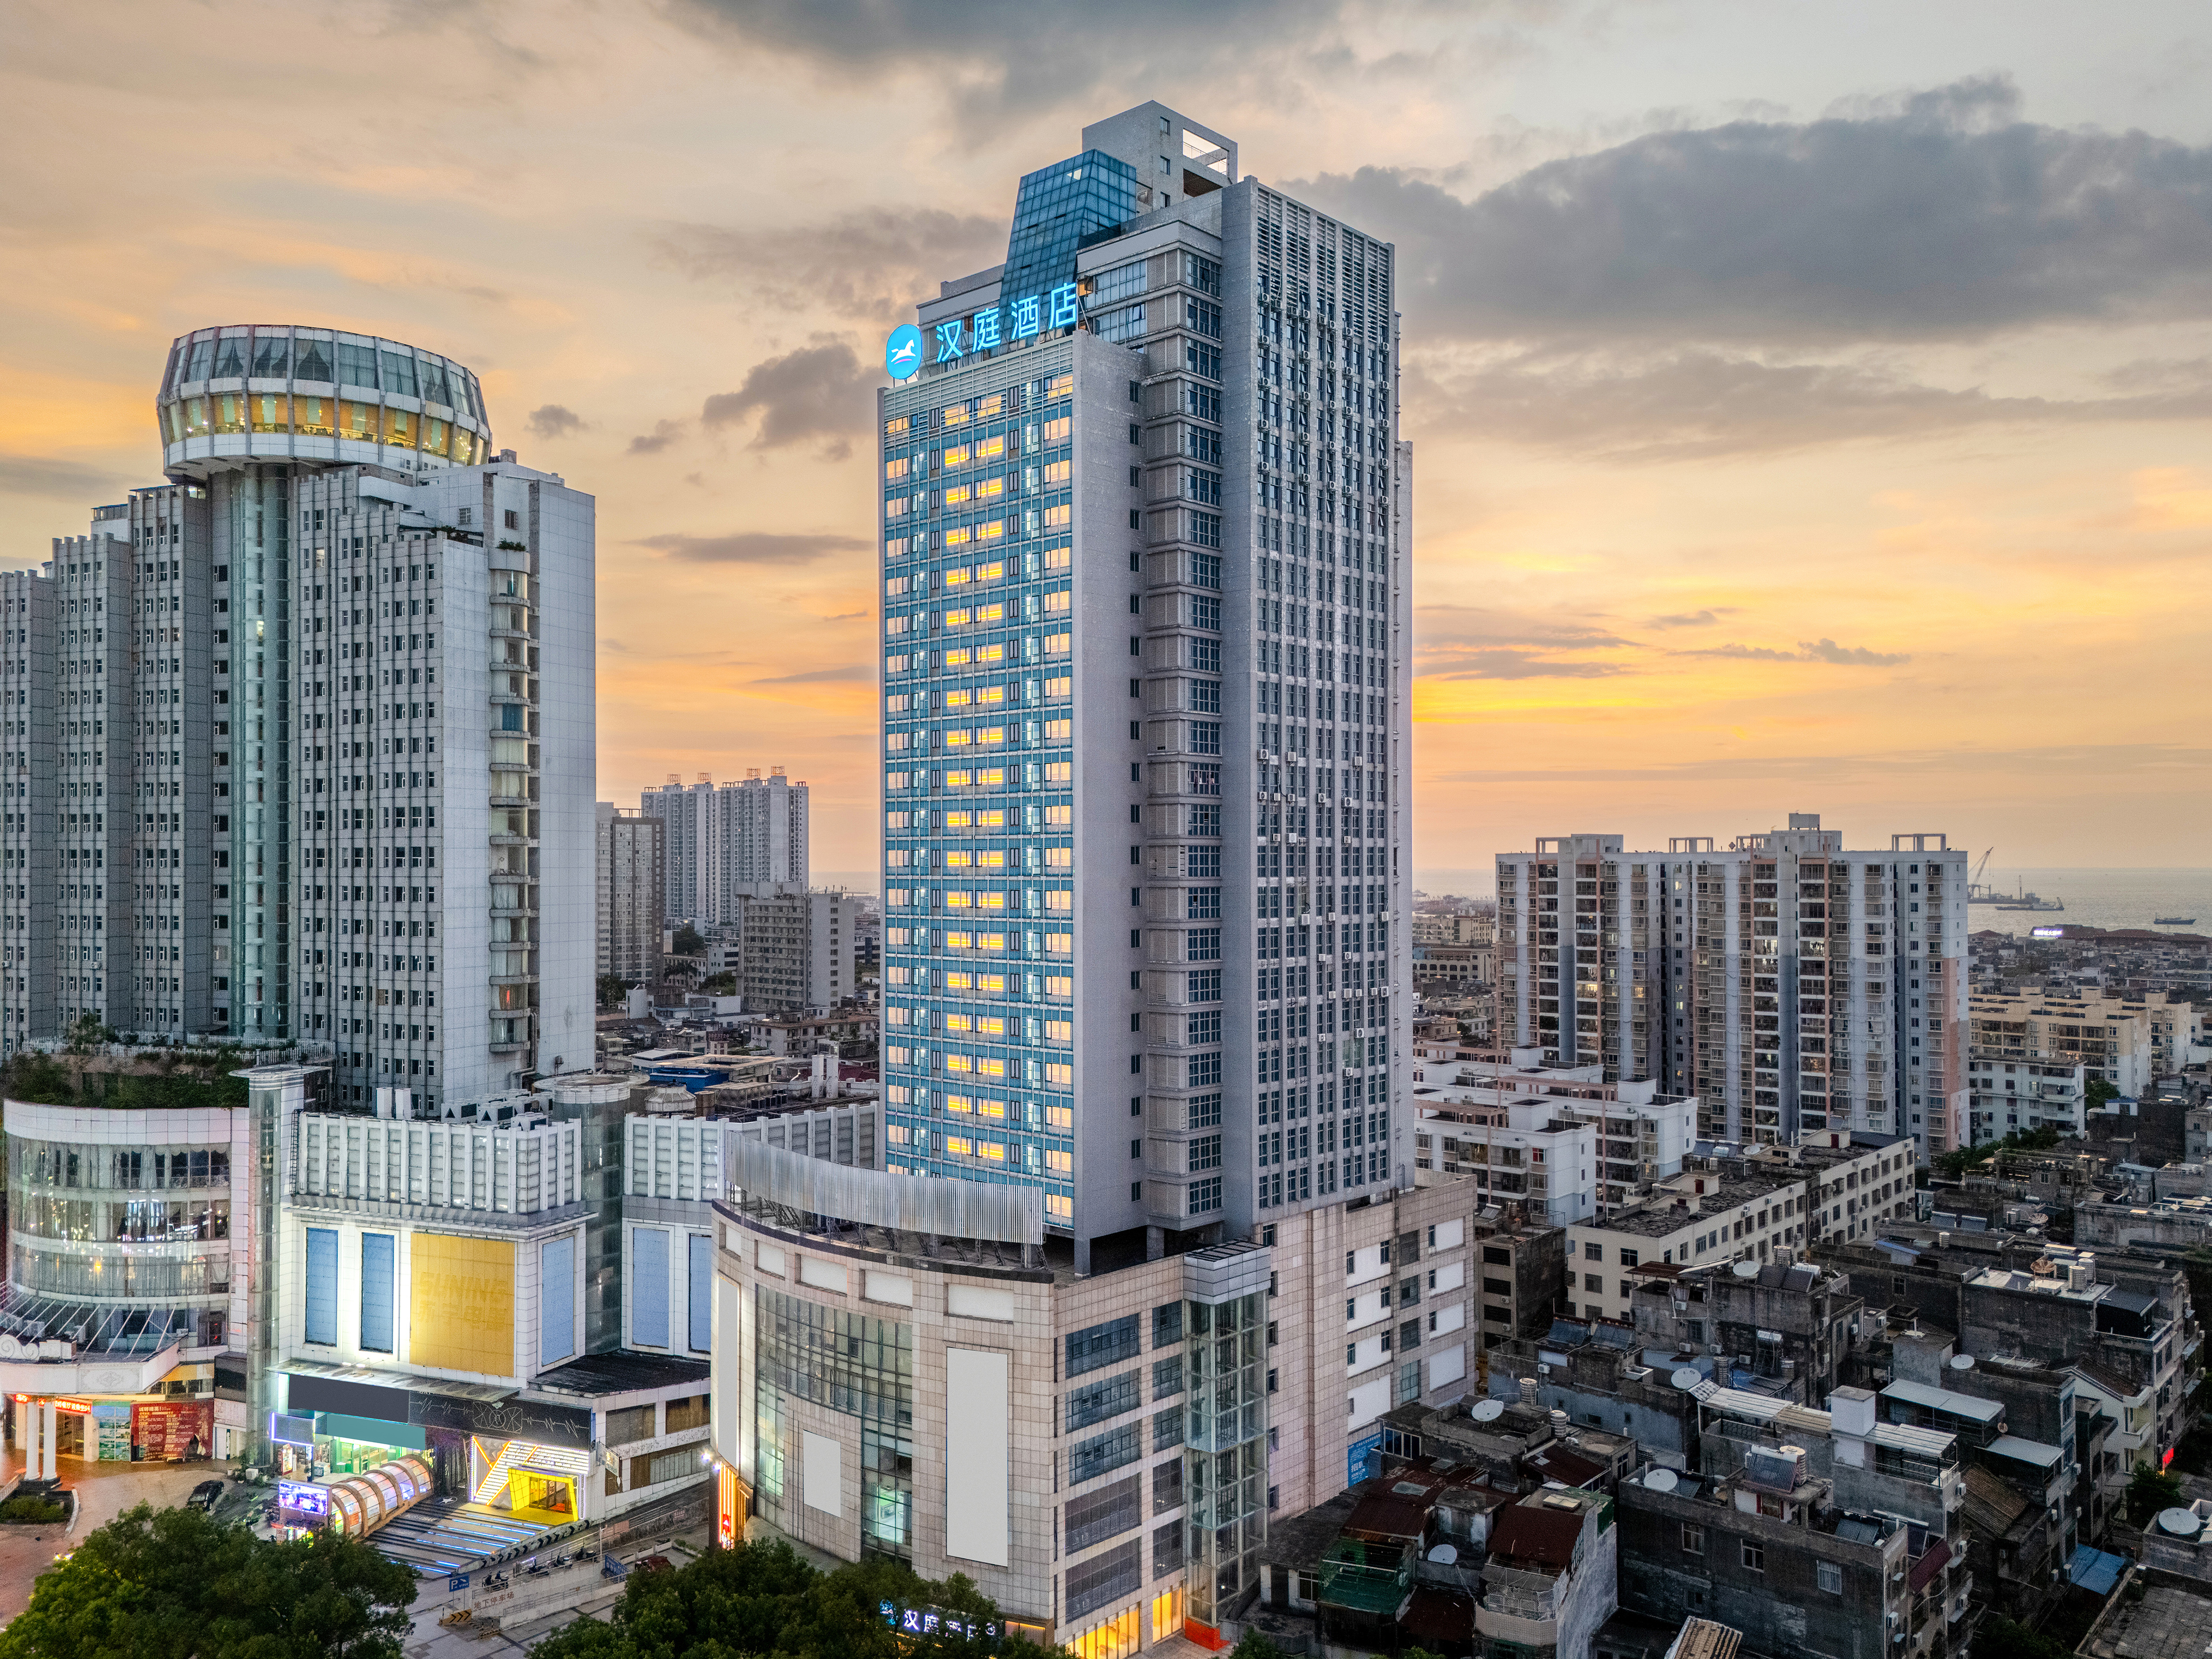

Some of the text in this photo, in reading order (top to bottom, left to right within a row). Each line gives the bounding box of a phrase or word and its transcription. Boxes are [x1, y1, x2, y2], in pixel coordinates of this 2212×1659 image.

[936, 282, 1077, 363] 汉庭酒店
[451, 1580, 458, 1590] P
[474, 1592, 514, 1609] 地下停车场
